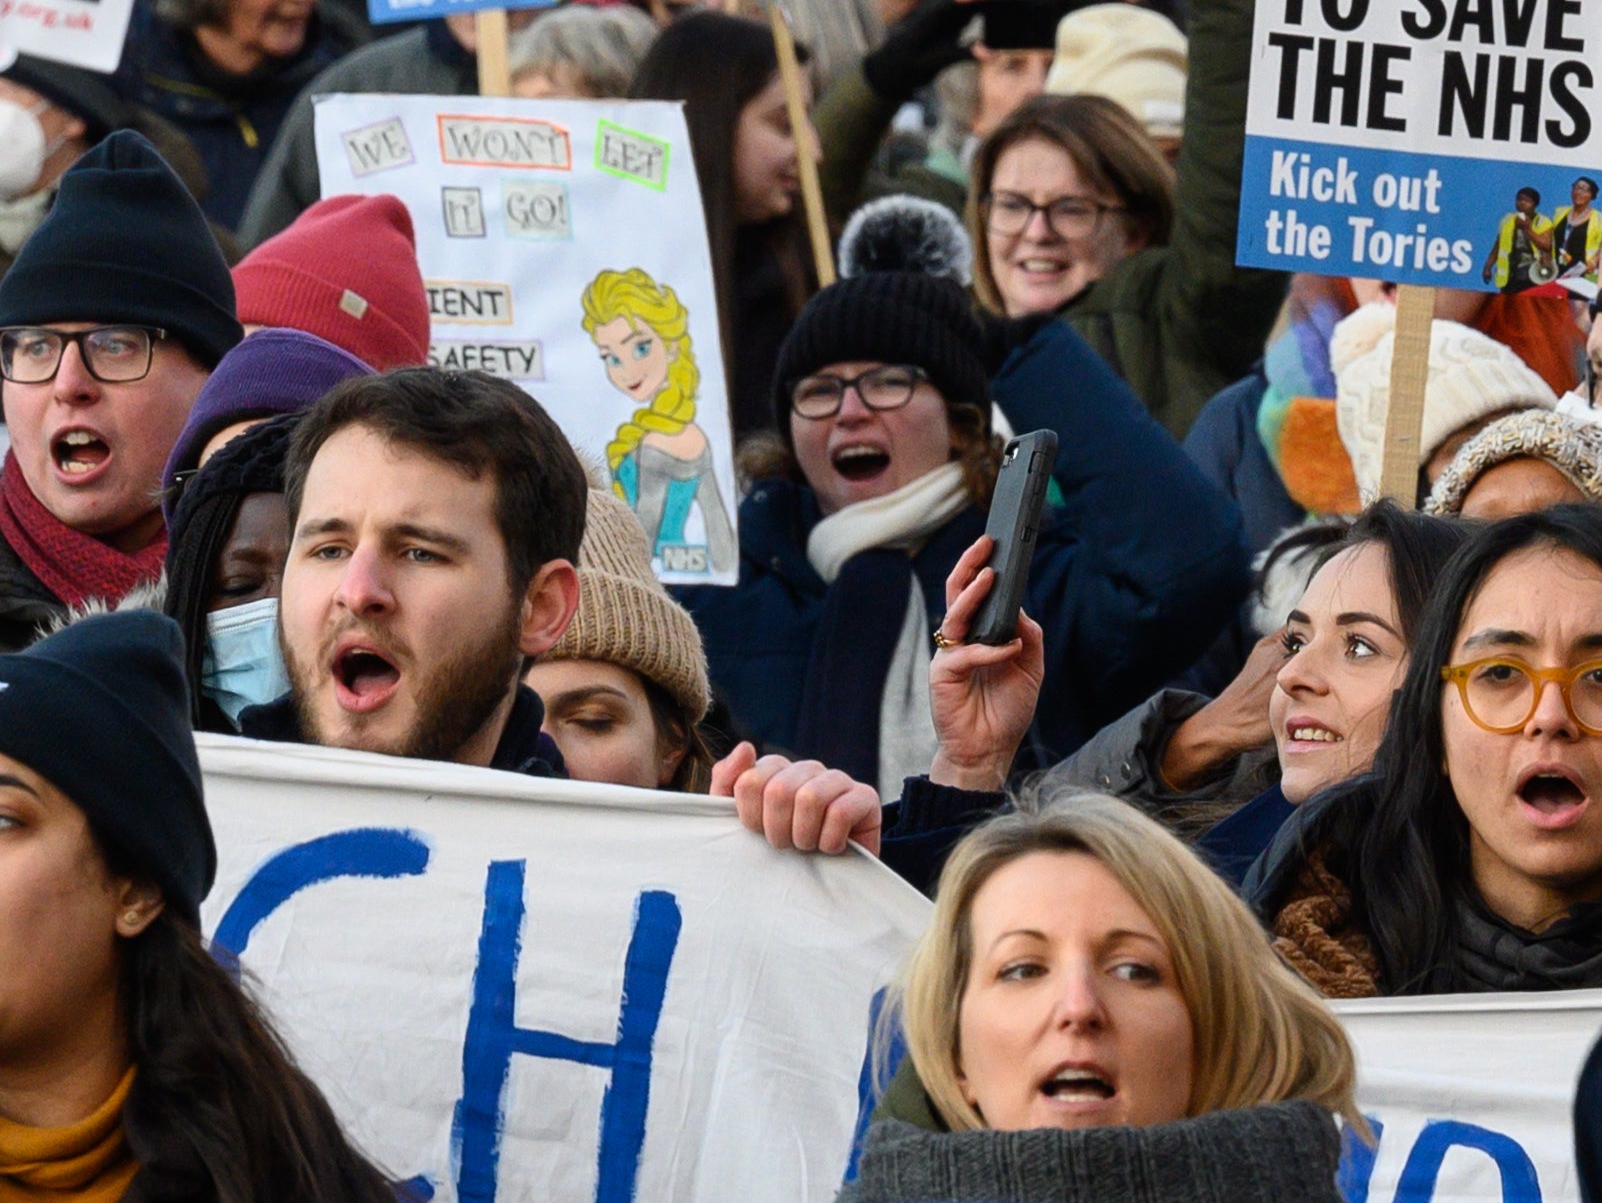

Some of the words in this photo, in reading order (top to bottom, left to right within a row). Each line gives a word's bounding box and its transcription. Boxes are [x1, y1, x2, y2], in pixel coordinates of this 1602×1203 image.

[1268, 31, 1412, 133] THE
[1437, 49, 1595, 148] NHS
[348, 124, 408, 170] WE
[601, 132, 665, 180] LET
[1269, 149, 1359, 205] Kick
[1372, 168, 1442, 214] out
[506, 192, 568, 231] GO!
[1264, 209, 1332, 260] the
[1347, 216, 1473, 275] Tories
